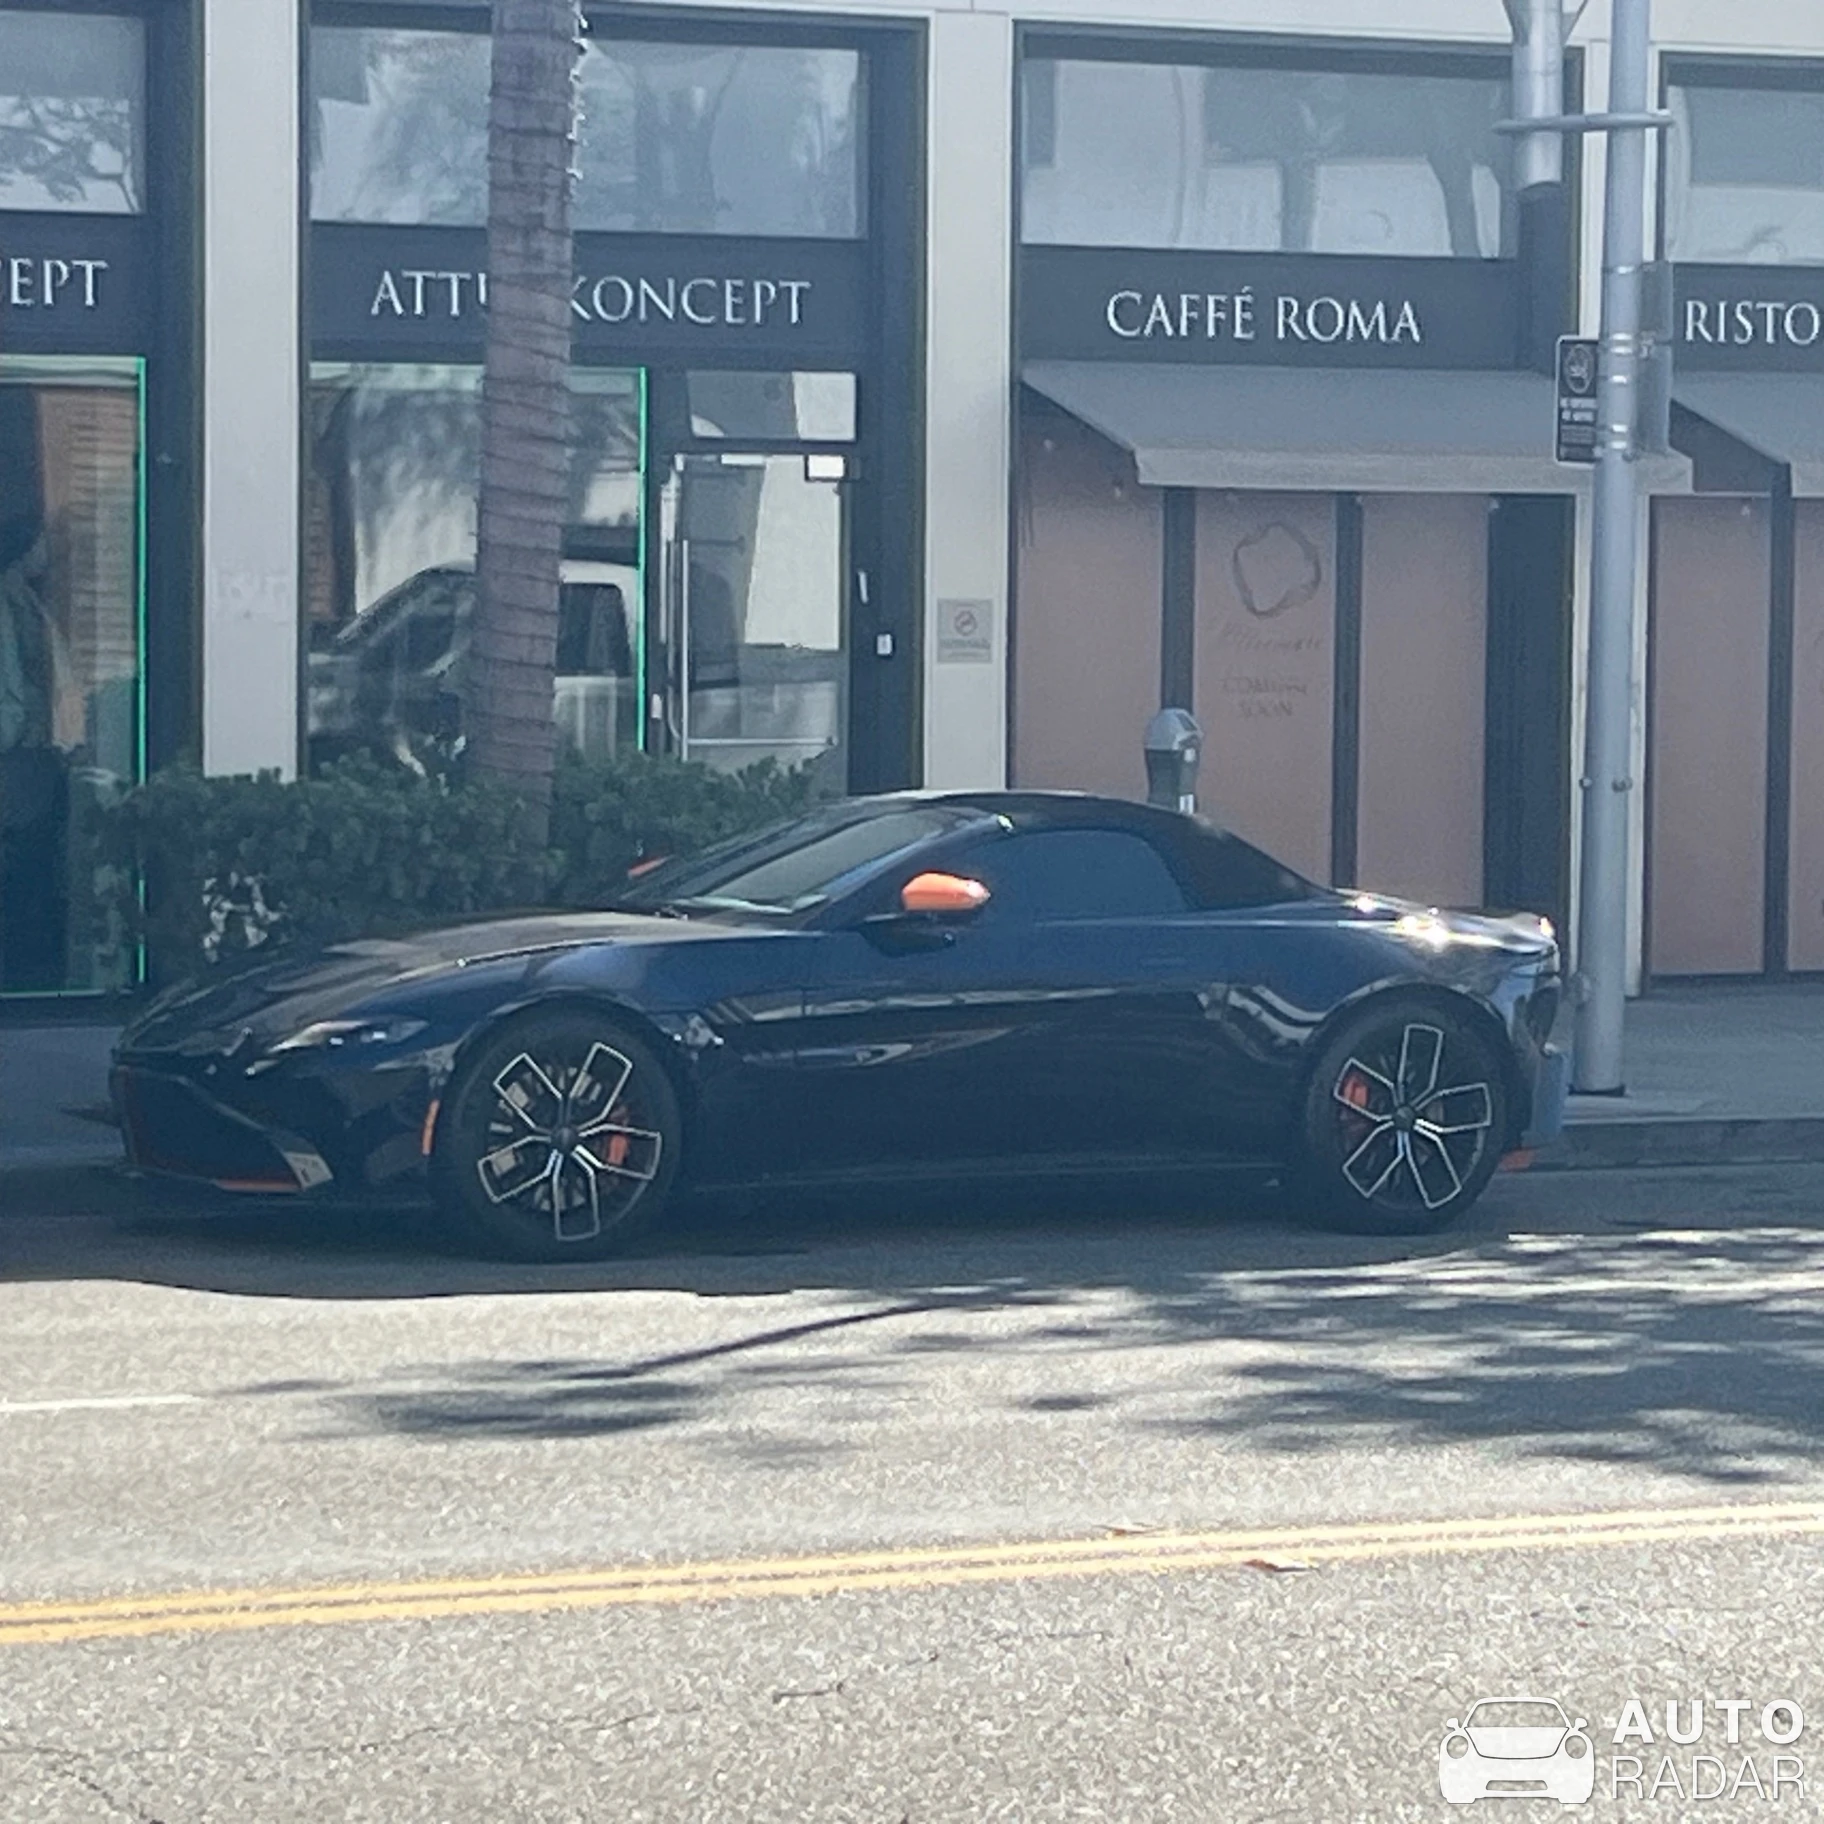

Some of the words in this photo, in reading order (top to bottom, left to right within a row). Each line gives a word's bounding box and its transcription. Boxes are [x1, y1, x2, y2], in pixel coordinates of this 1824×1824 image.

[0, 257, 109, 307] EPT
[1106, 285, 1254, 338] CAFFÉ
[1277, 295, 1421, 343] ROMA
[1684, 300, 1820, 345] RISTO
